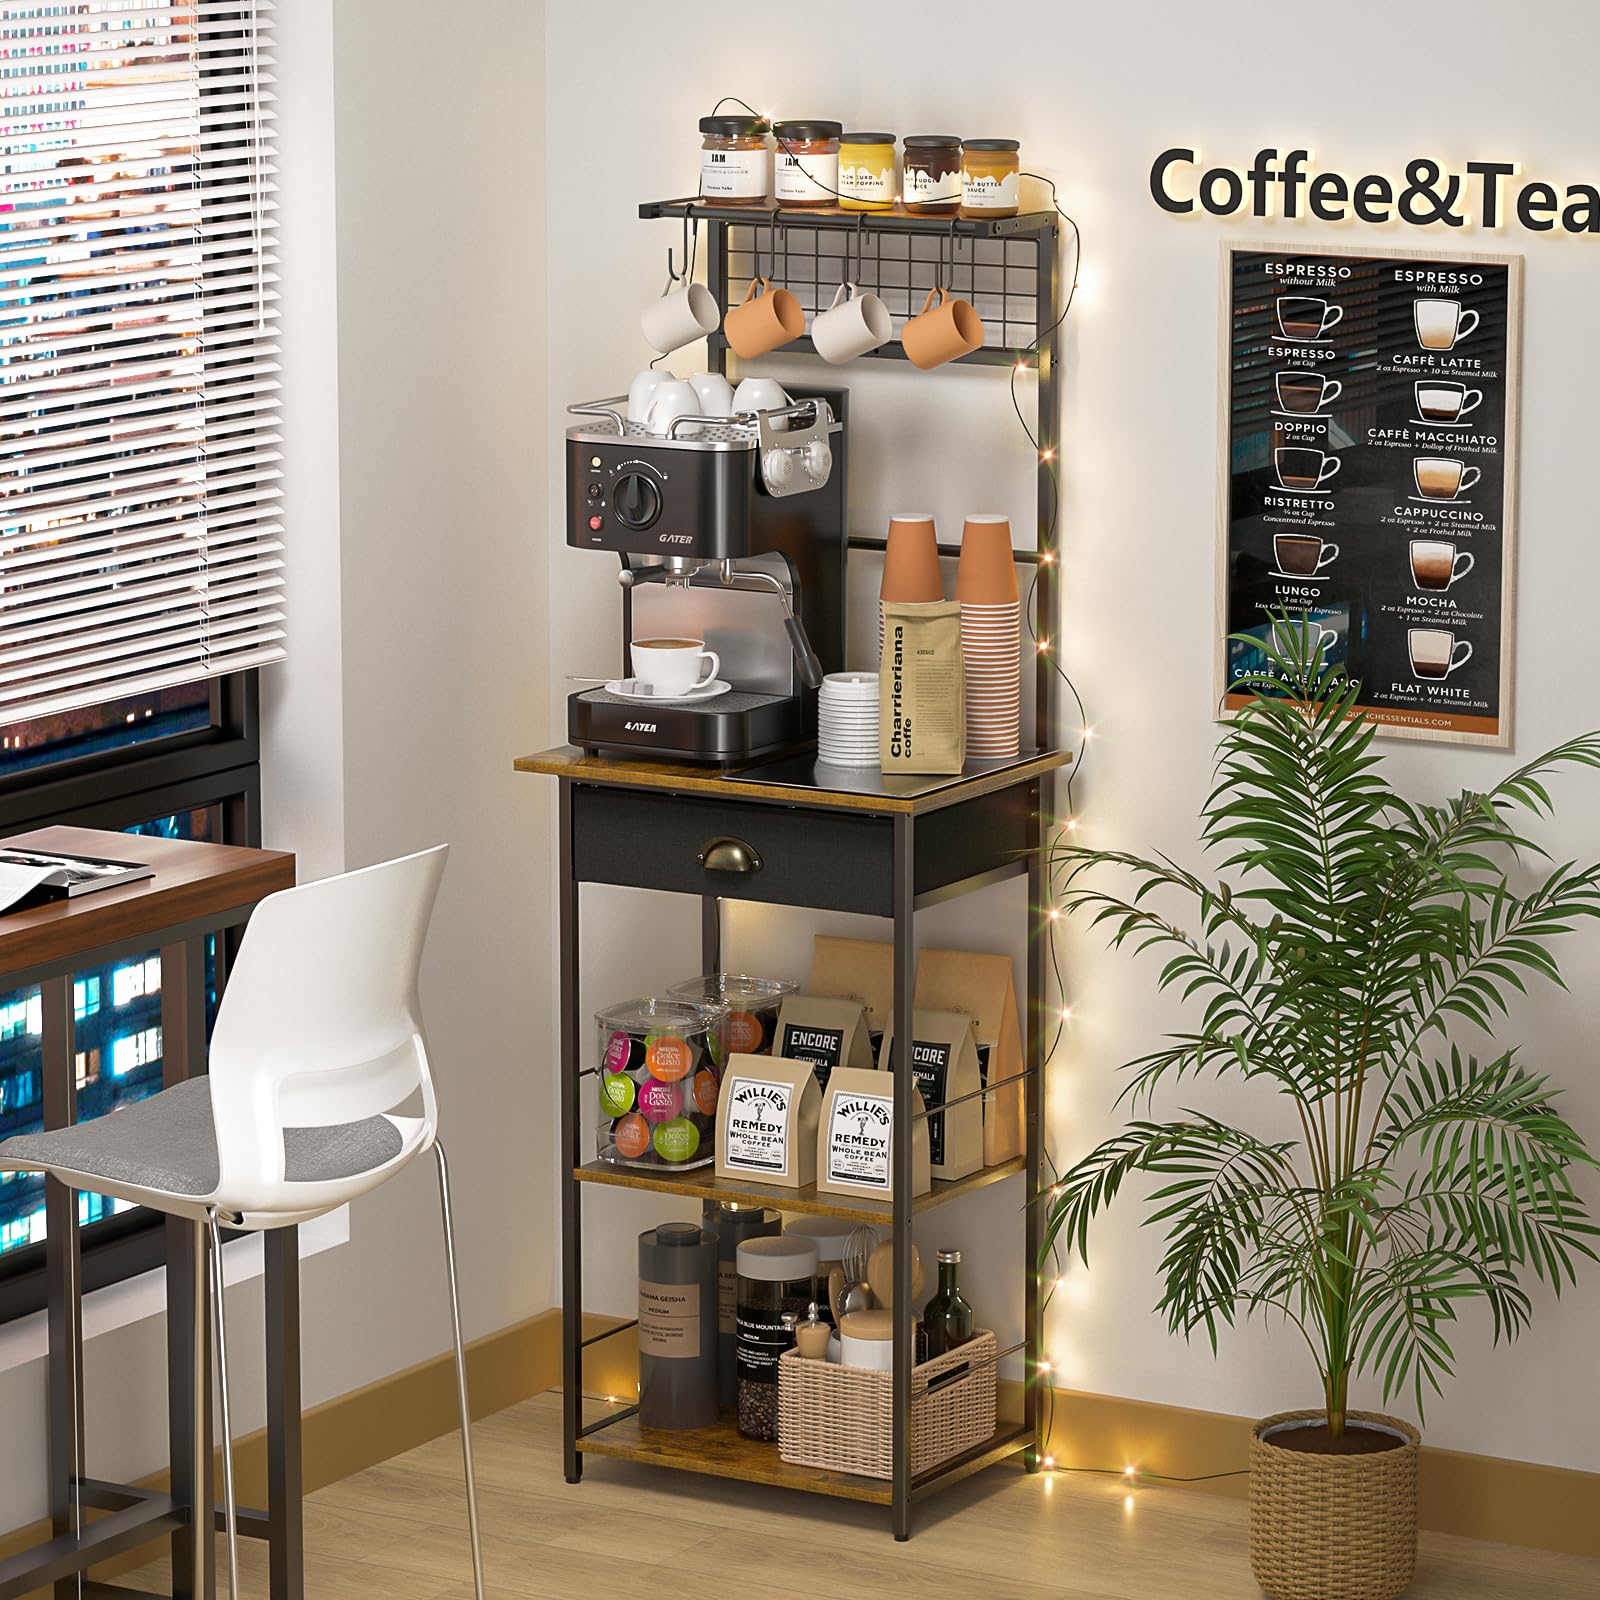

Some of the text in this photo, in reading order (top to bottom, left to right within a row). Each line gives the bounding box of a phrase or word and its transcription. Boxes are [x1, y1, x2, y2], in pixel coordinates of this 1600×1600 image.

[711, 153, 726, 163] JAM
[785, 157, 799, 166] JAM
[1150, 147, 1600, 233] Coffee&Tea
[1265, 263, 1351, 278] ESPRESSO
[1280, 276, 1336, 287] without Milk
[1394, 270, 1483, 286] ESPRESSO
[1416, 284, 1460, 294] with Milk
[1268, 347, 1335, 360] ESPRESSO
[1302, 360, 1316, 368] Cup
[1392, 354, 1481, 369] CAFFÈ LATTE
[1392, 365, 1421, 374] Espresso
[1451, 369, 1480, 377] Steamed
[1274, 422, 1327, 434] DOPPIO
[1301, 434, 1315, 442] Cup
[1367, 428, 1497, 446] CAFFÈ MACCHIATO
[1384, 440, 1412, 448] Espresso
[1421, 442, 1444, 451] Dollop
[1445, 444, 1453, 452] of
[1453, 444, 1480, 453] Frothed
[1264, 496, 1335, 510] RISTRETTO
[1301, 510, 1315, 518] Cup
[1394, 506, 1484, 522] CAPPUCCINO
[1263, 515, 1335, 527] Concentrated Espresso
[1396, 517, 1425, 525] Espresso
[1451, 521, 1480, 530] Steamed
[659, 533, 693, 544] GATER
[1429, 528, 1455, 536] Frothed
[1275, 584, 1321, 597] LUNGO
[1299, 597, 1313, 606] Cup
[1406, 596, 1457, 609] MOCHA
[1269, 603, 1313, 613] Conentraed
[1313, 607, 1342, 615] Espresso
[1396, 606, 1425, 614] Espresso
[1450, 610, 1484, 619] Chocolate
[1421, 616, 1451, 624] Steamed
[1451, 618, 1467, 626] Milk
[890, 626, 904, 758] Charrieriana
[1391, 682, 1470, 699] FLAT WHITE
[1389, 693, 1417, 701] Espresso
[1443, 698, 1472, 707] Steamed
[903, 717, 912, 759] coffe
[791, 1031, 838, 1051] ENCORE
[656, 1051, 680, 1059] Dolce
[649, 1091, 673, 1100] Dolce
[735, 1087, 786, 1111] WILLIE'S
[837, 1101, 889, 1126] WILLIE'S
[732, 1119, 782, 1133] REMEDY
[729, 1130, 758, 1140] WHOLE
[761, 1136, 784, 1144] BEAN
[835, 1133, 886, 1148] REMEDY
[742, 1140, 771, 1148] COFFEE
[831, 1145, 861, 1155] WHOLE
[864, 1150, 887, 1159] BEAN
[844, 1154, 874, 1163] COFFEE
